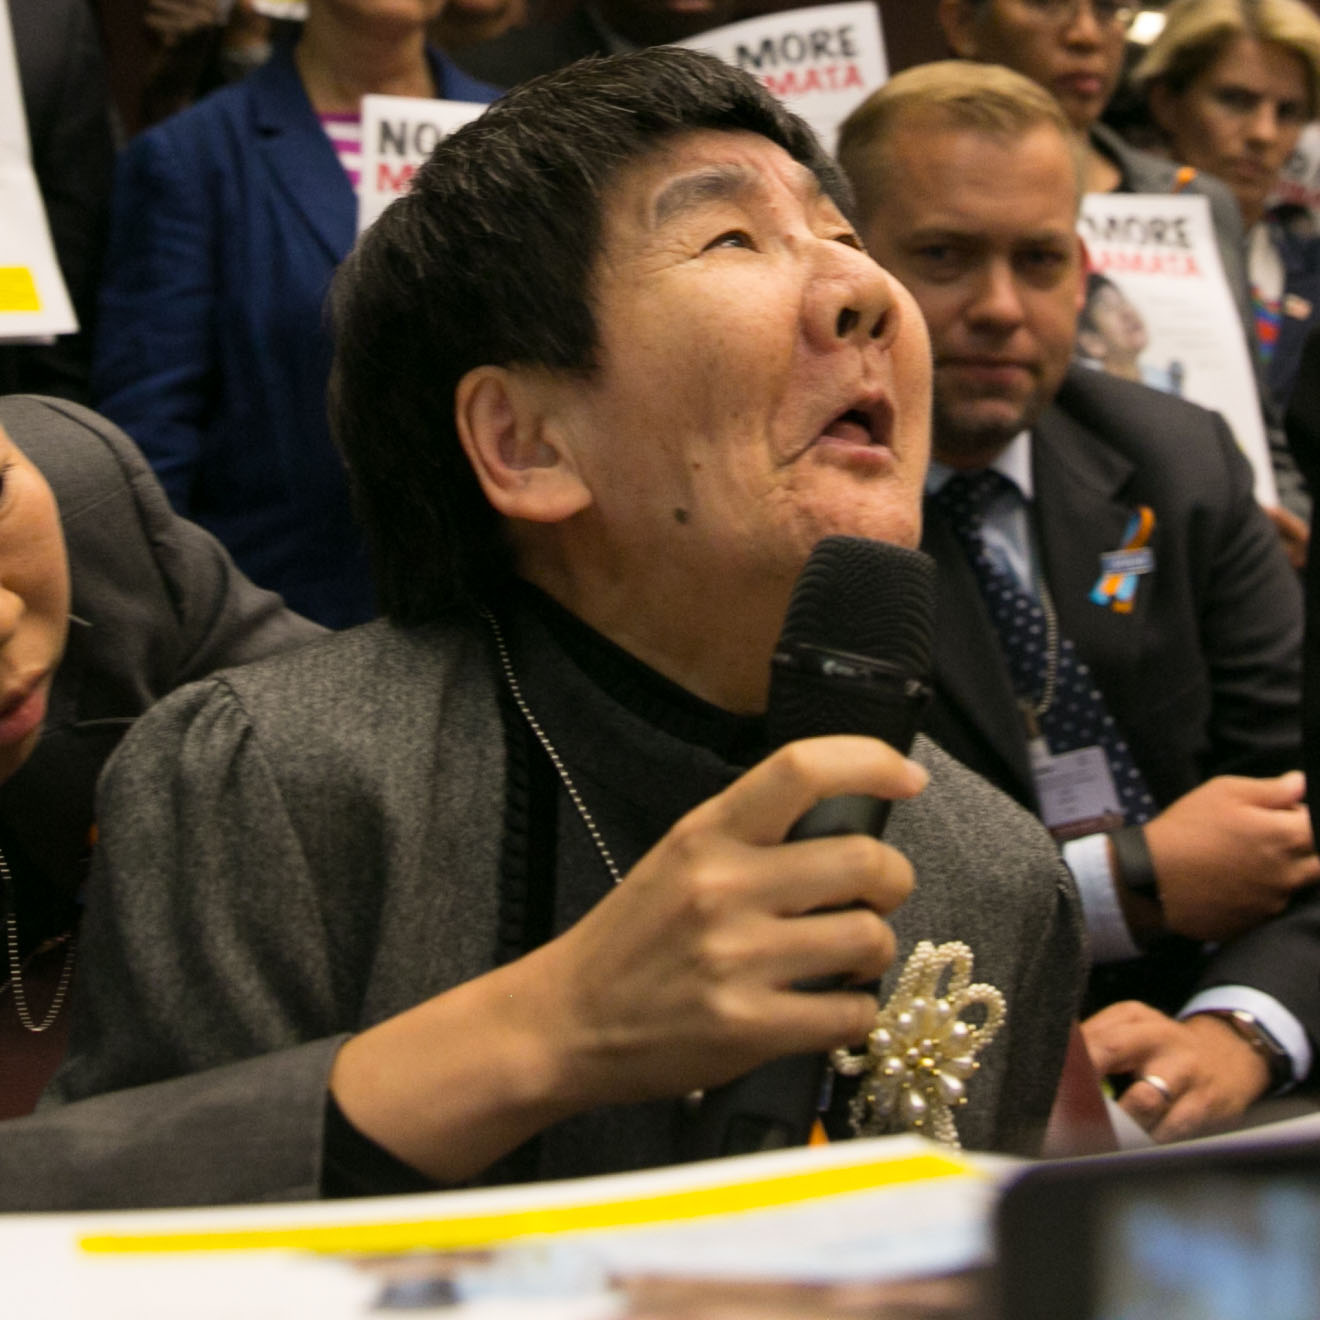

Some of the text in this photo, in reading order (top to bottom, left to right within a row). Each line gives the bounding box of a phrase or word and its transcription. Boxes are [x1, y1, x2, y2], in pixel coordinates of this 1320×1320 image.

[735, 25, 858, 69] MORE
[763, 64, 866, 95] MATA
[378, 119, 442, 158] NO
